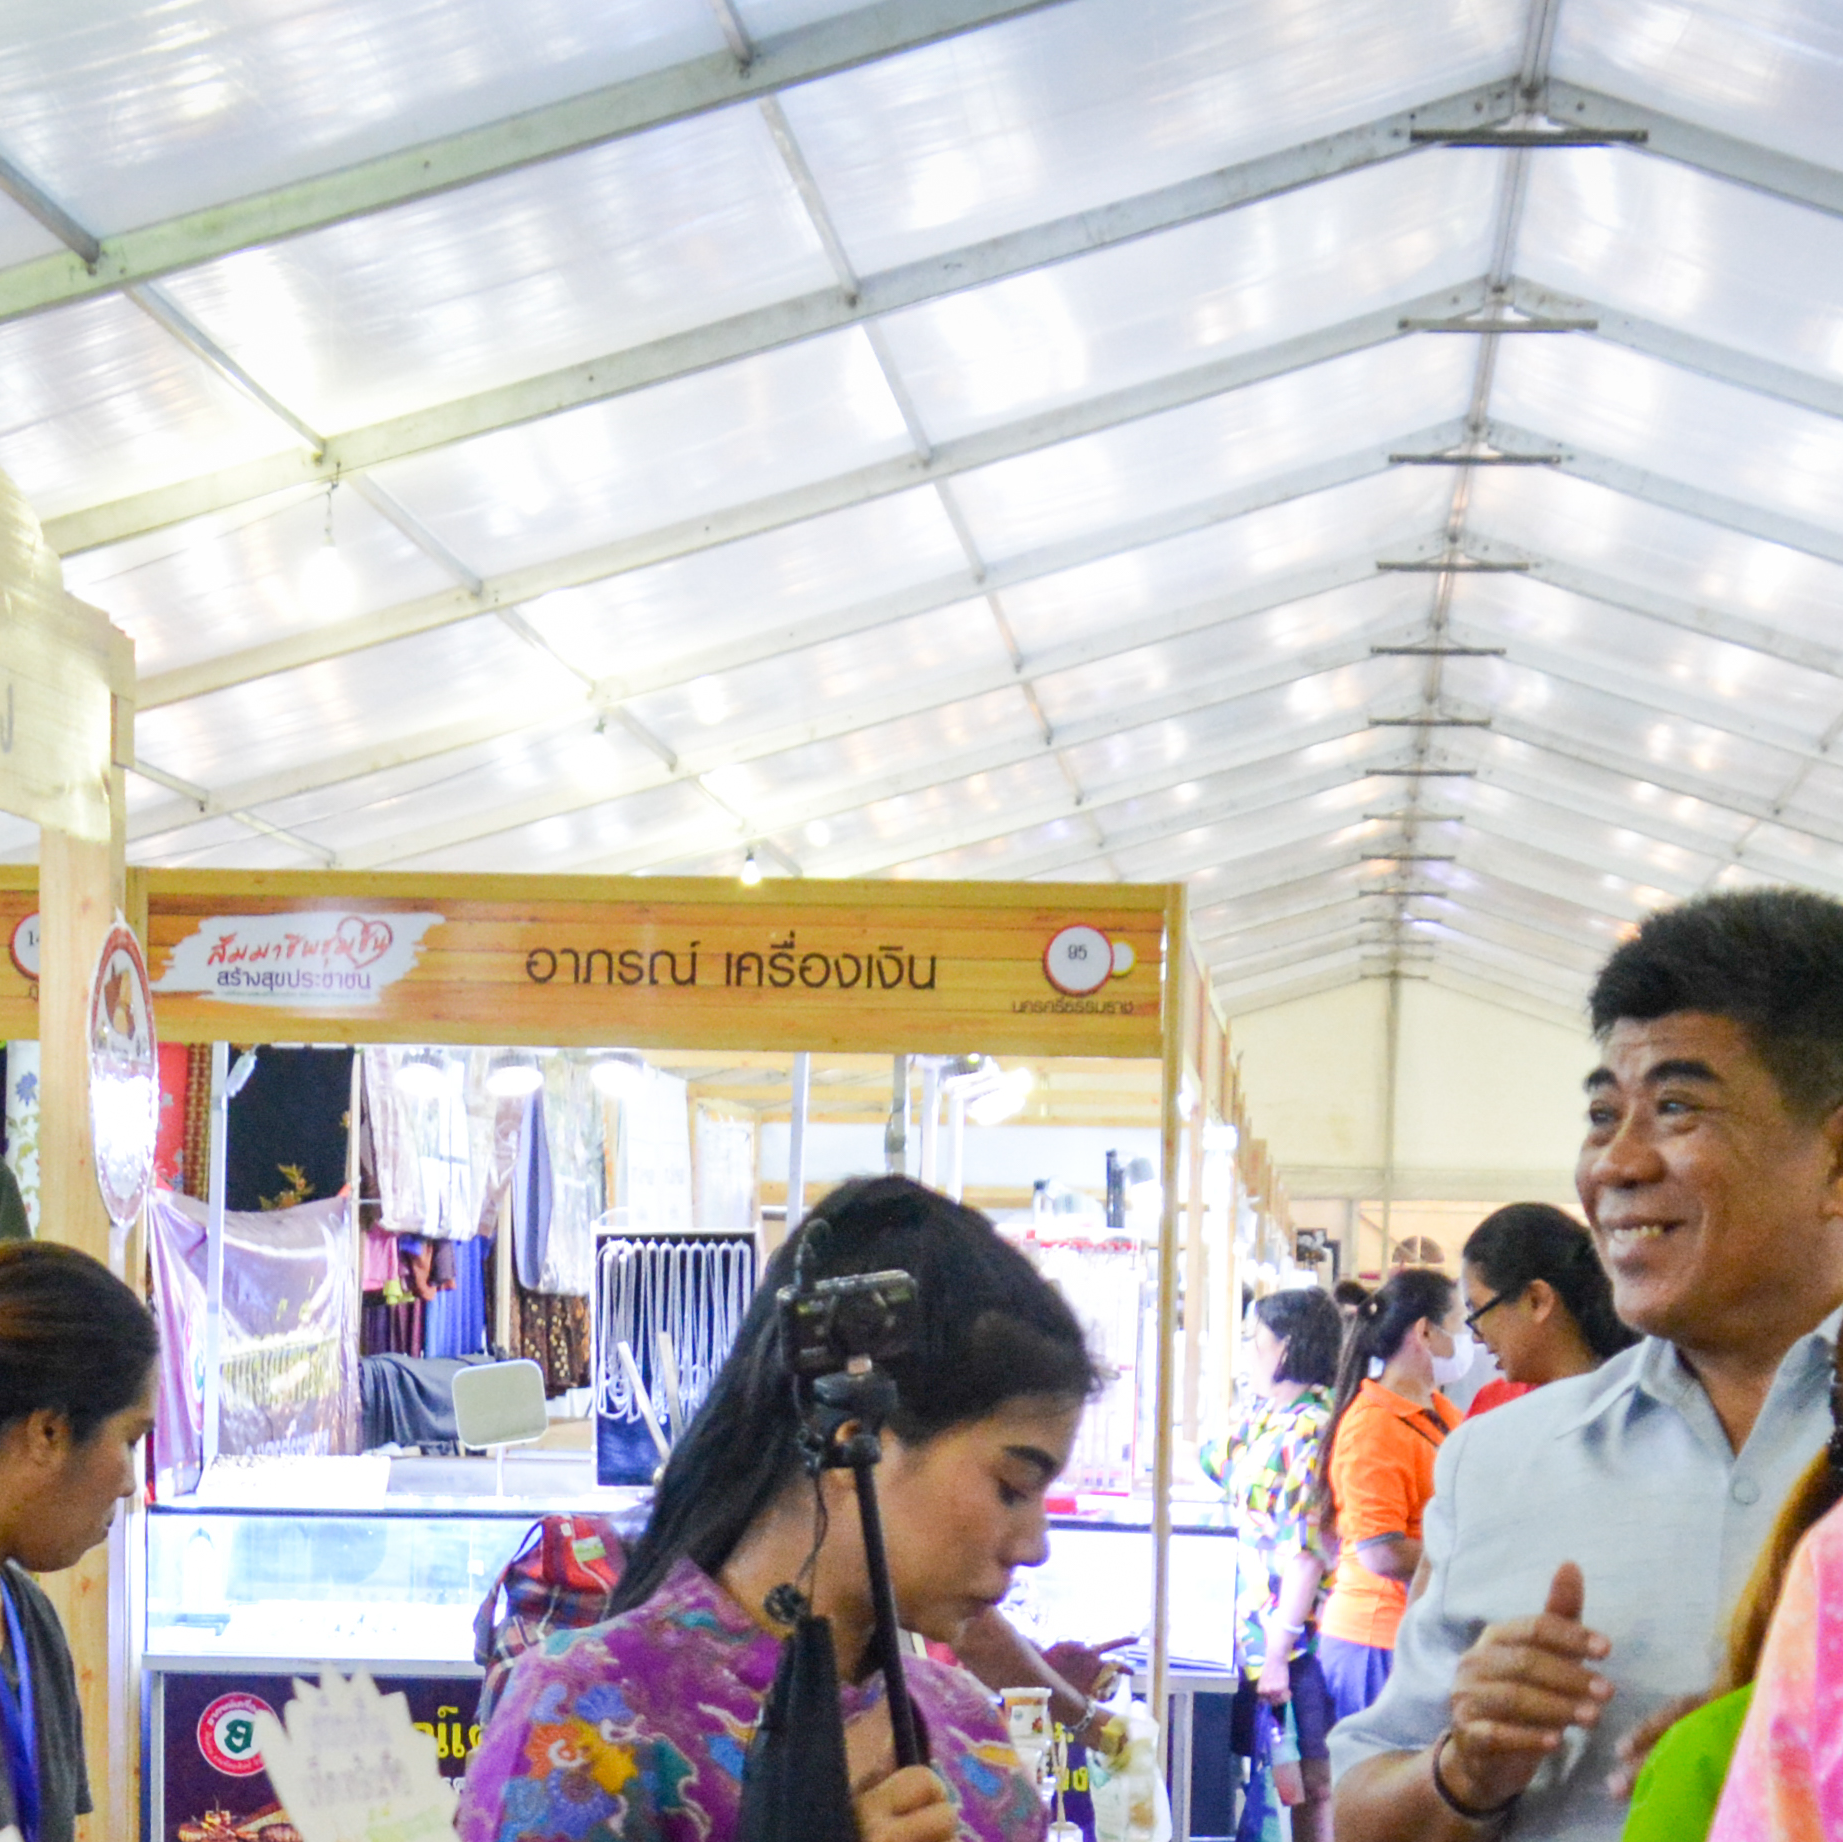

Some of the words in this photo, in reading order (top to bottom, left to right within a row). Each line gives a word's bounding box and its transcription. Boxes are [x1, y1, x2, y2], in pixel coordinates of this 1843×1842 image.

[216, 967, 372, 992] สร้างสุขประชาชน
[525, 940, 701, 986] อาภรณ์
[724, 930, 937, 991] เครื่องเงิน
